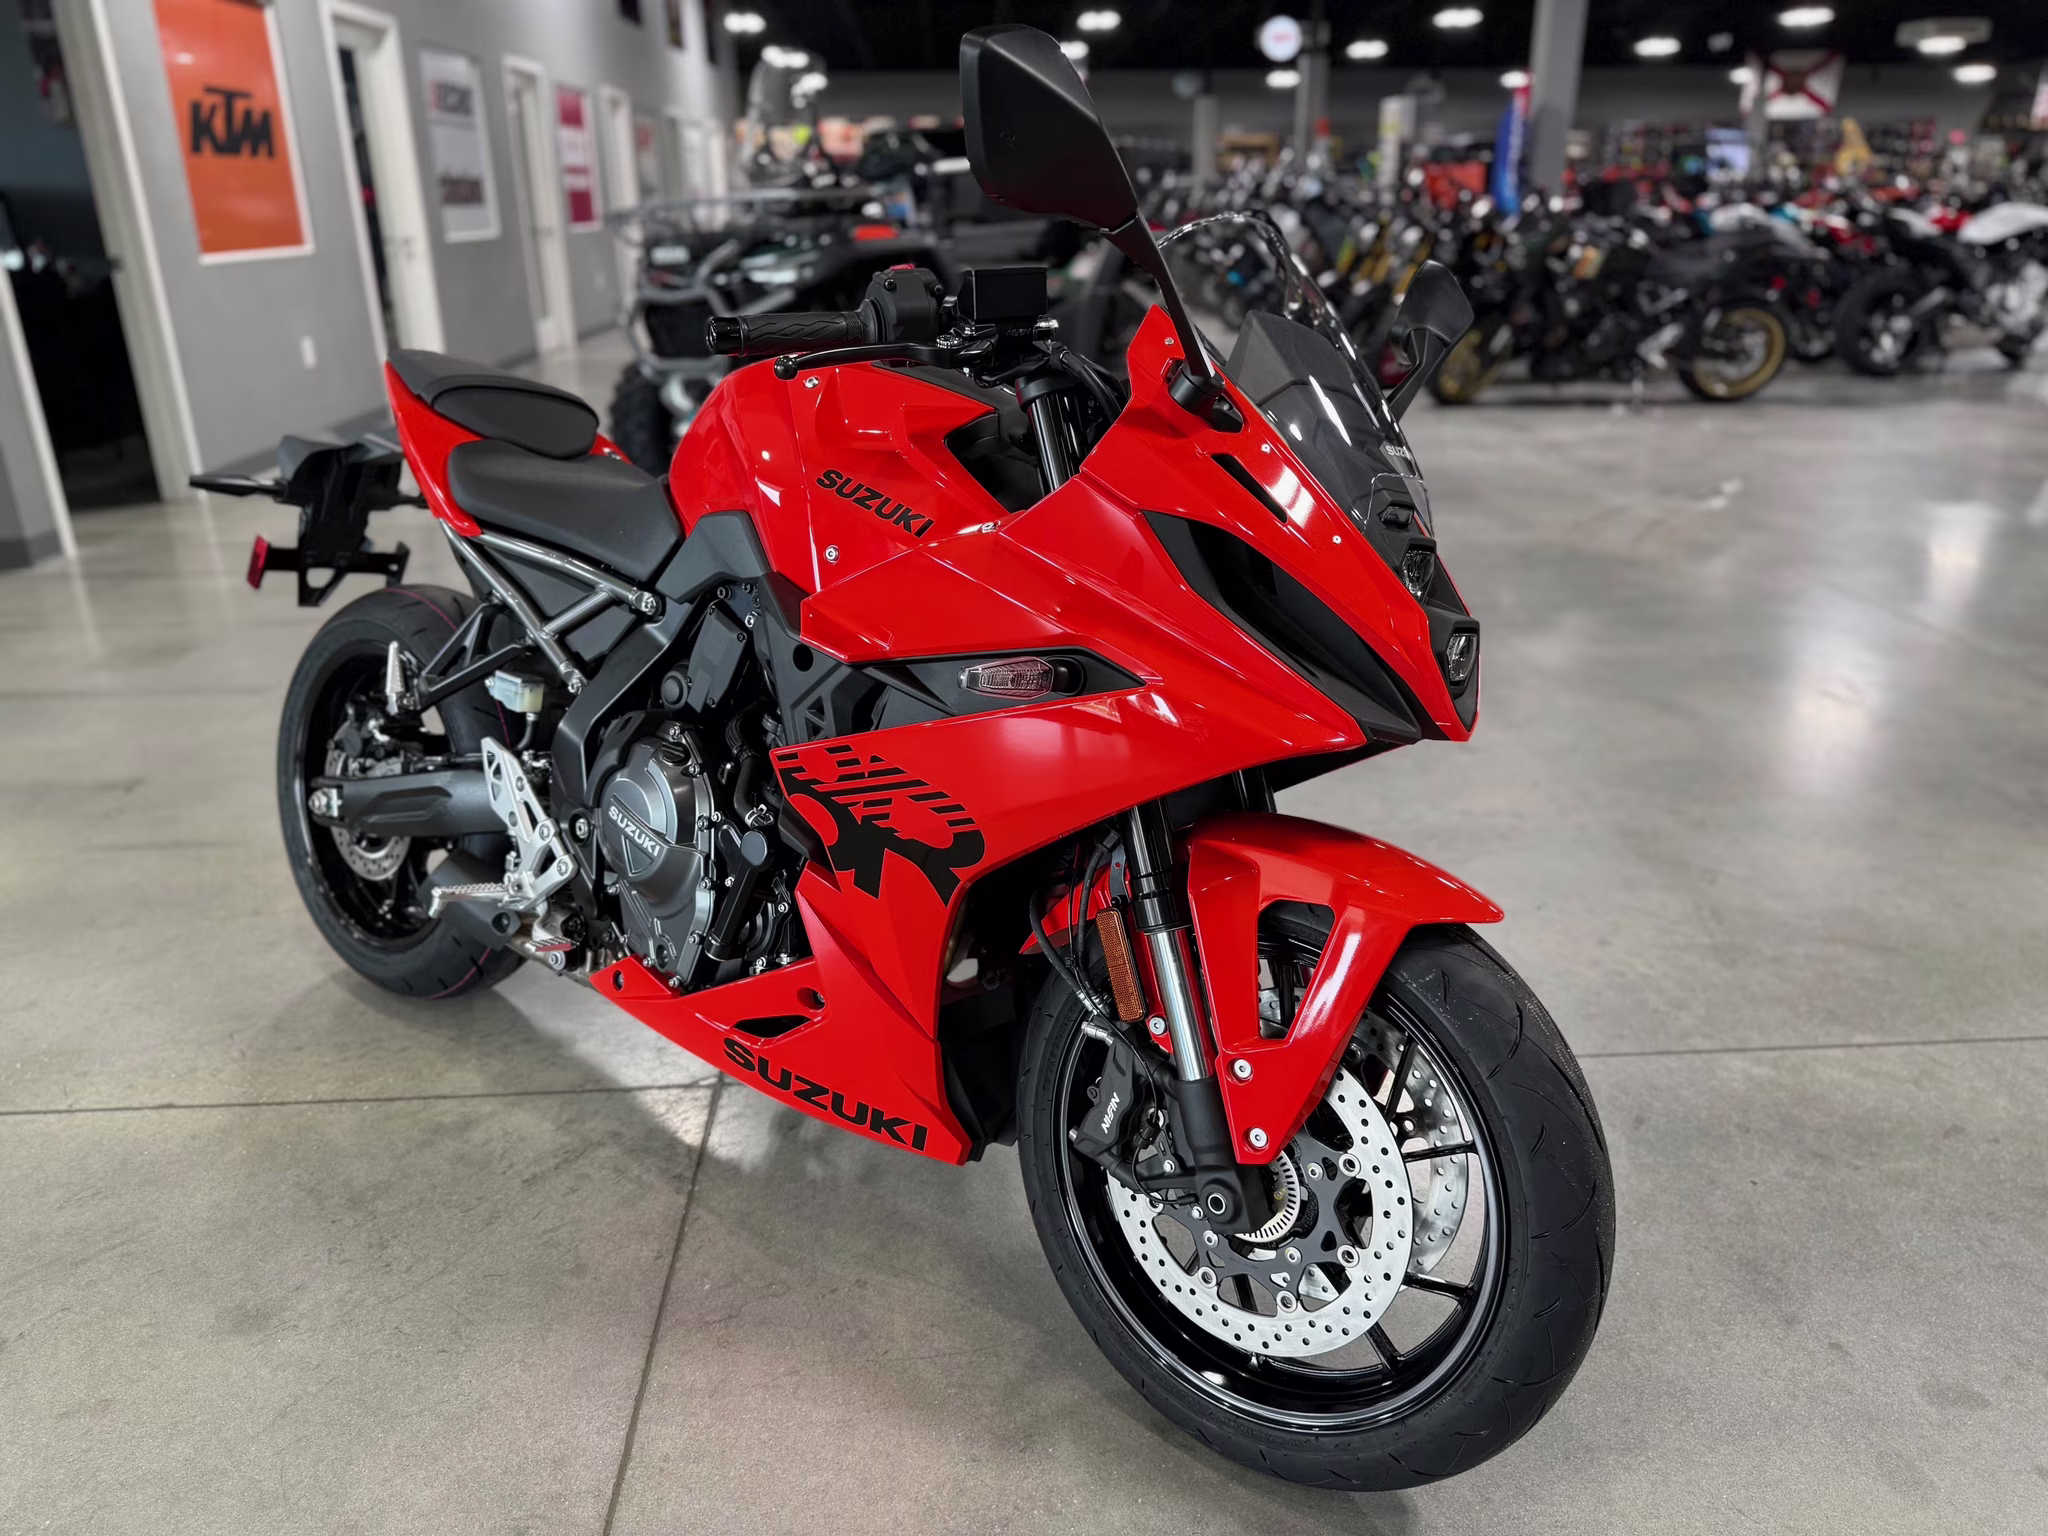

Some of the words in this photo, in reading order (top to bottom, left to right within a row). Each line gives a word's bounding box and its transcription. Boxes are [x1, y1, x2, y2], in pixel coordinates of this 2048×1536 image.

[191, 84, 274, 159] KTM
[816, 469, 935, 539] SUZUKI
[608, 805, 661, 857] SUZUKI
[723, 1037, 928, 1152] SUZUKI
